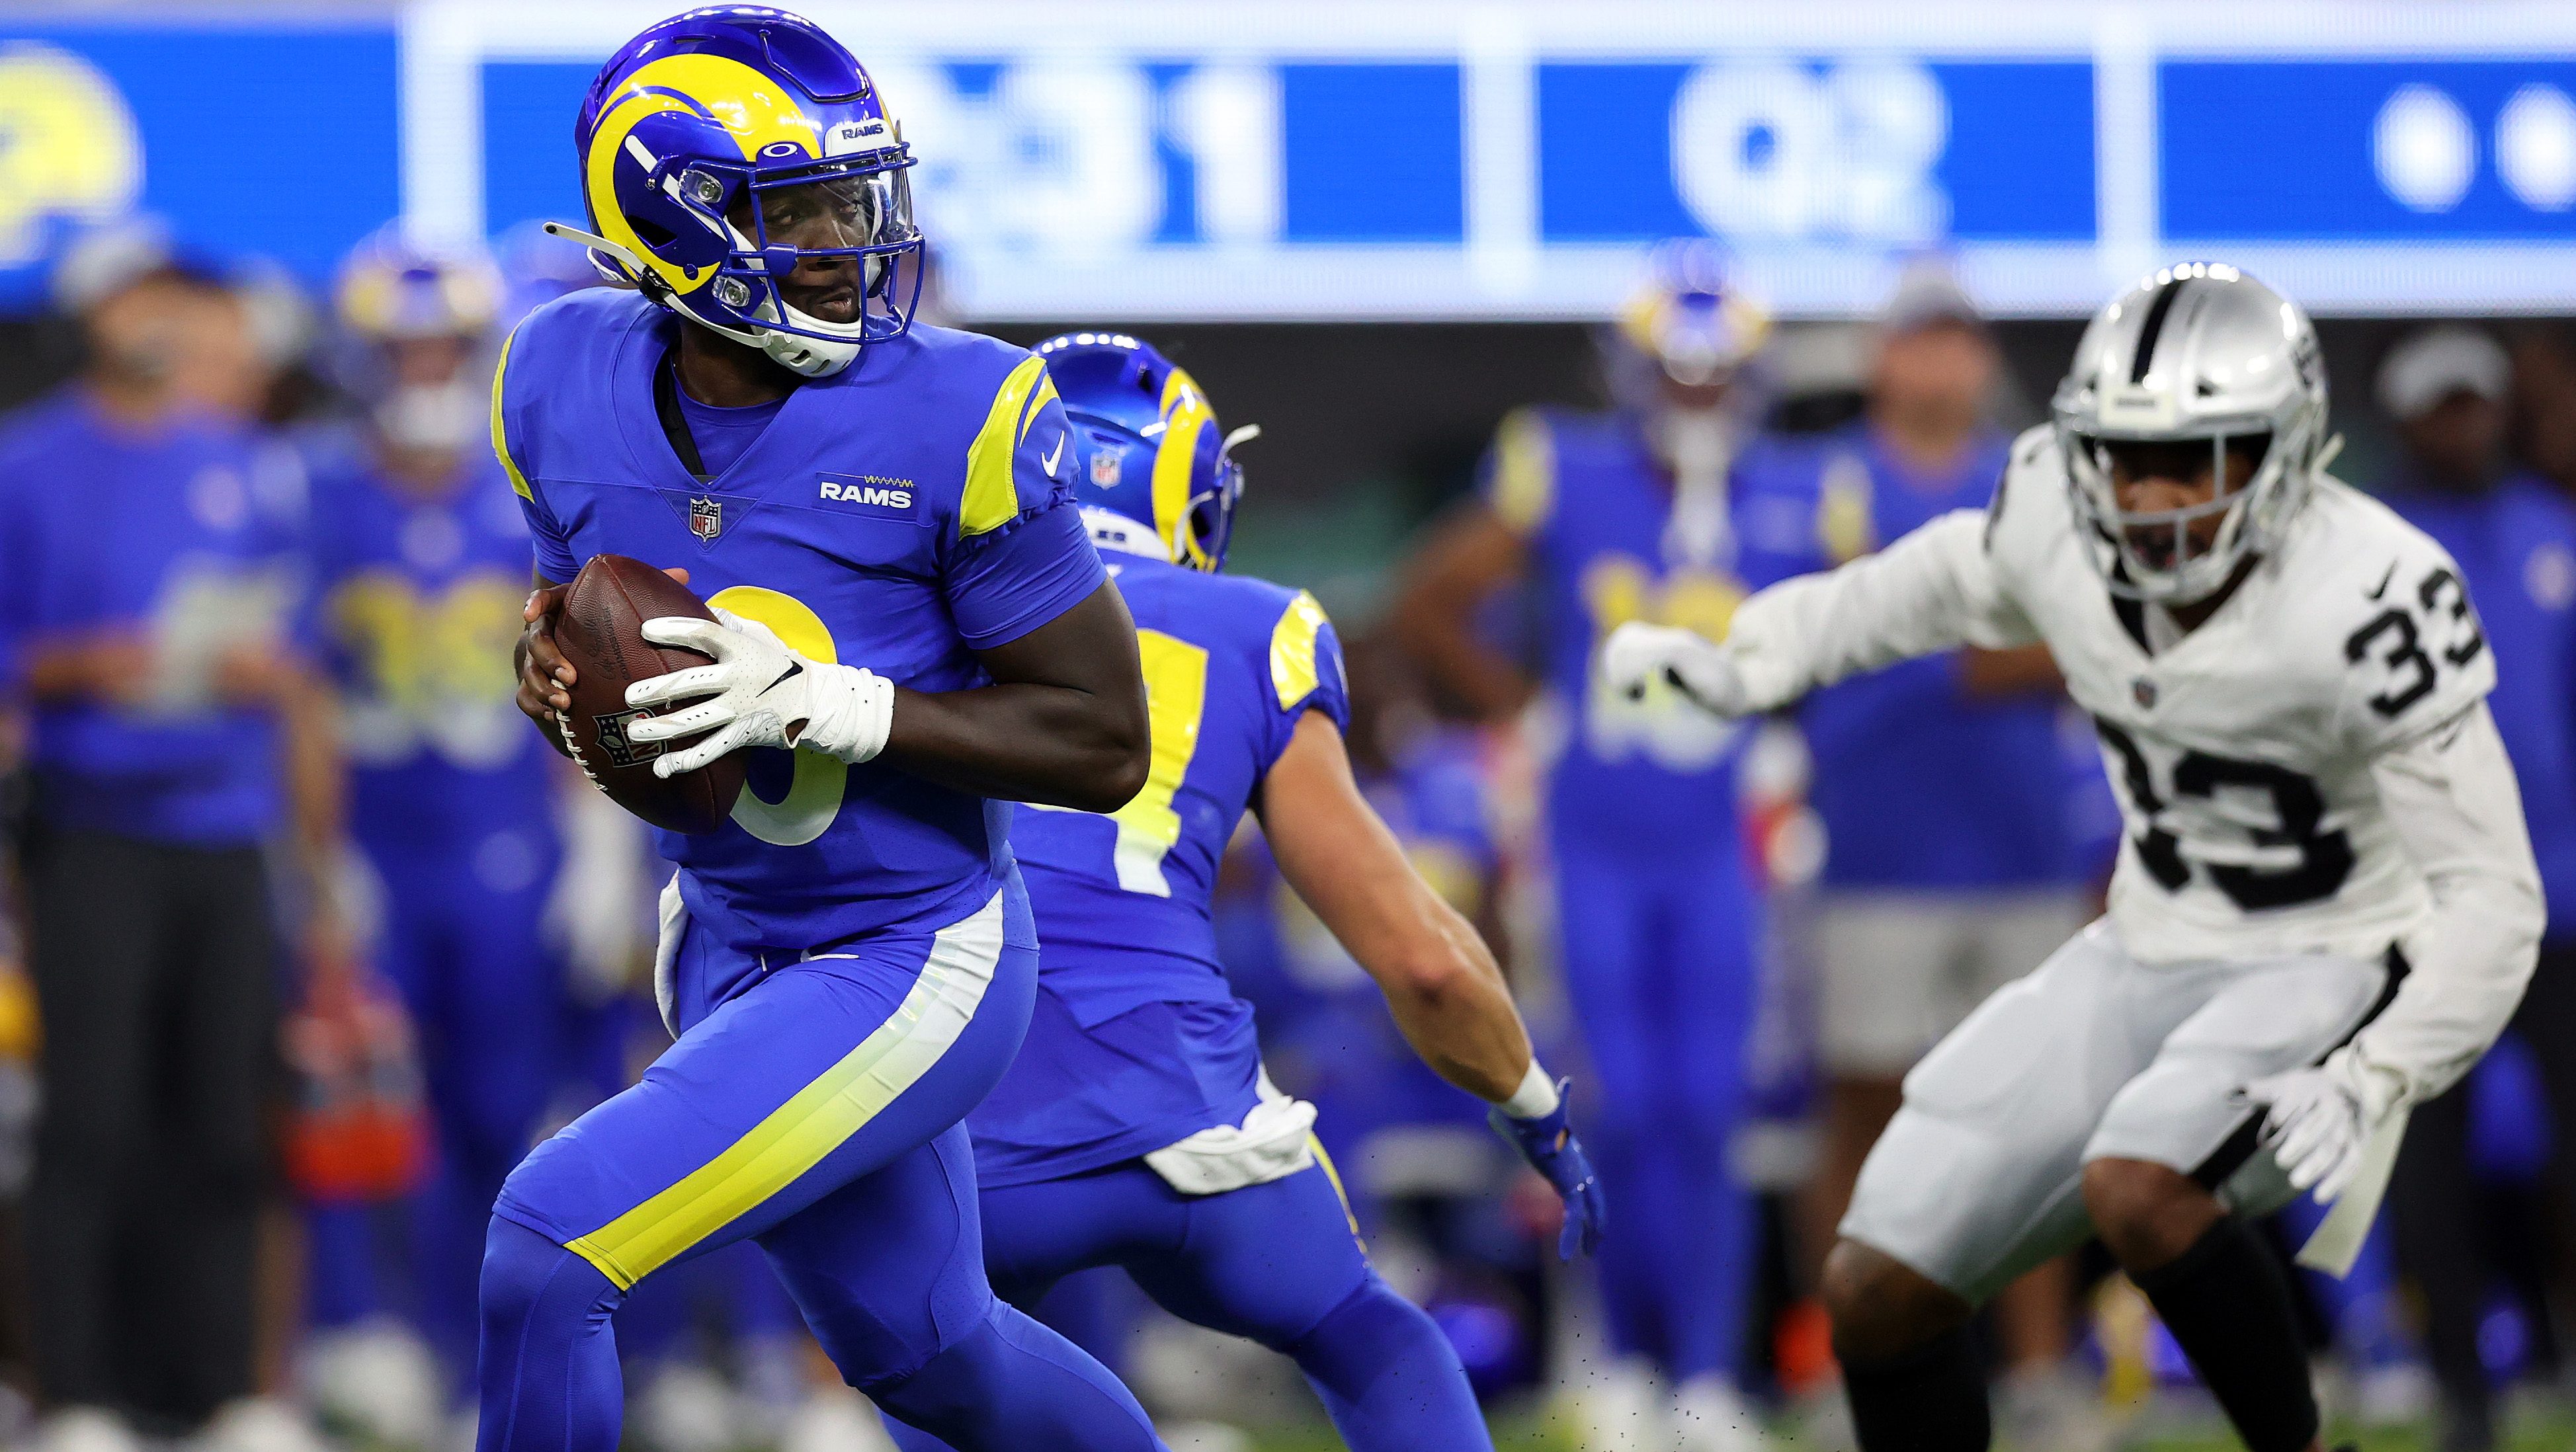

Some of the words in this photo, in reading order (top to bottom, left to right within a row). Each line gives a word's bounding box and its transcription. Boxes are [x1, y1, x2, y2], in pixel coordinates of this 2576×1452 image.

[842, 124, 884, 140] RAMS
[819, 481, 912, 509] RAMS
[694, 515, 716, 534] NFL
[2345, 565, 2483, 719] 33
